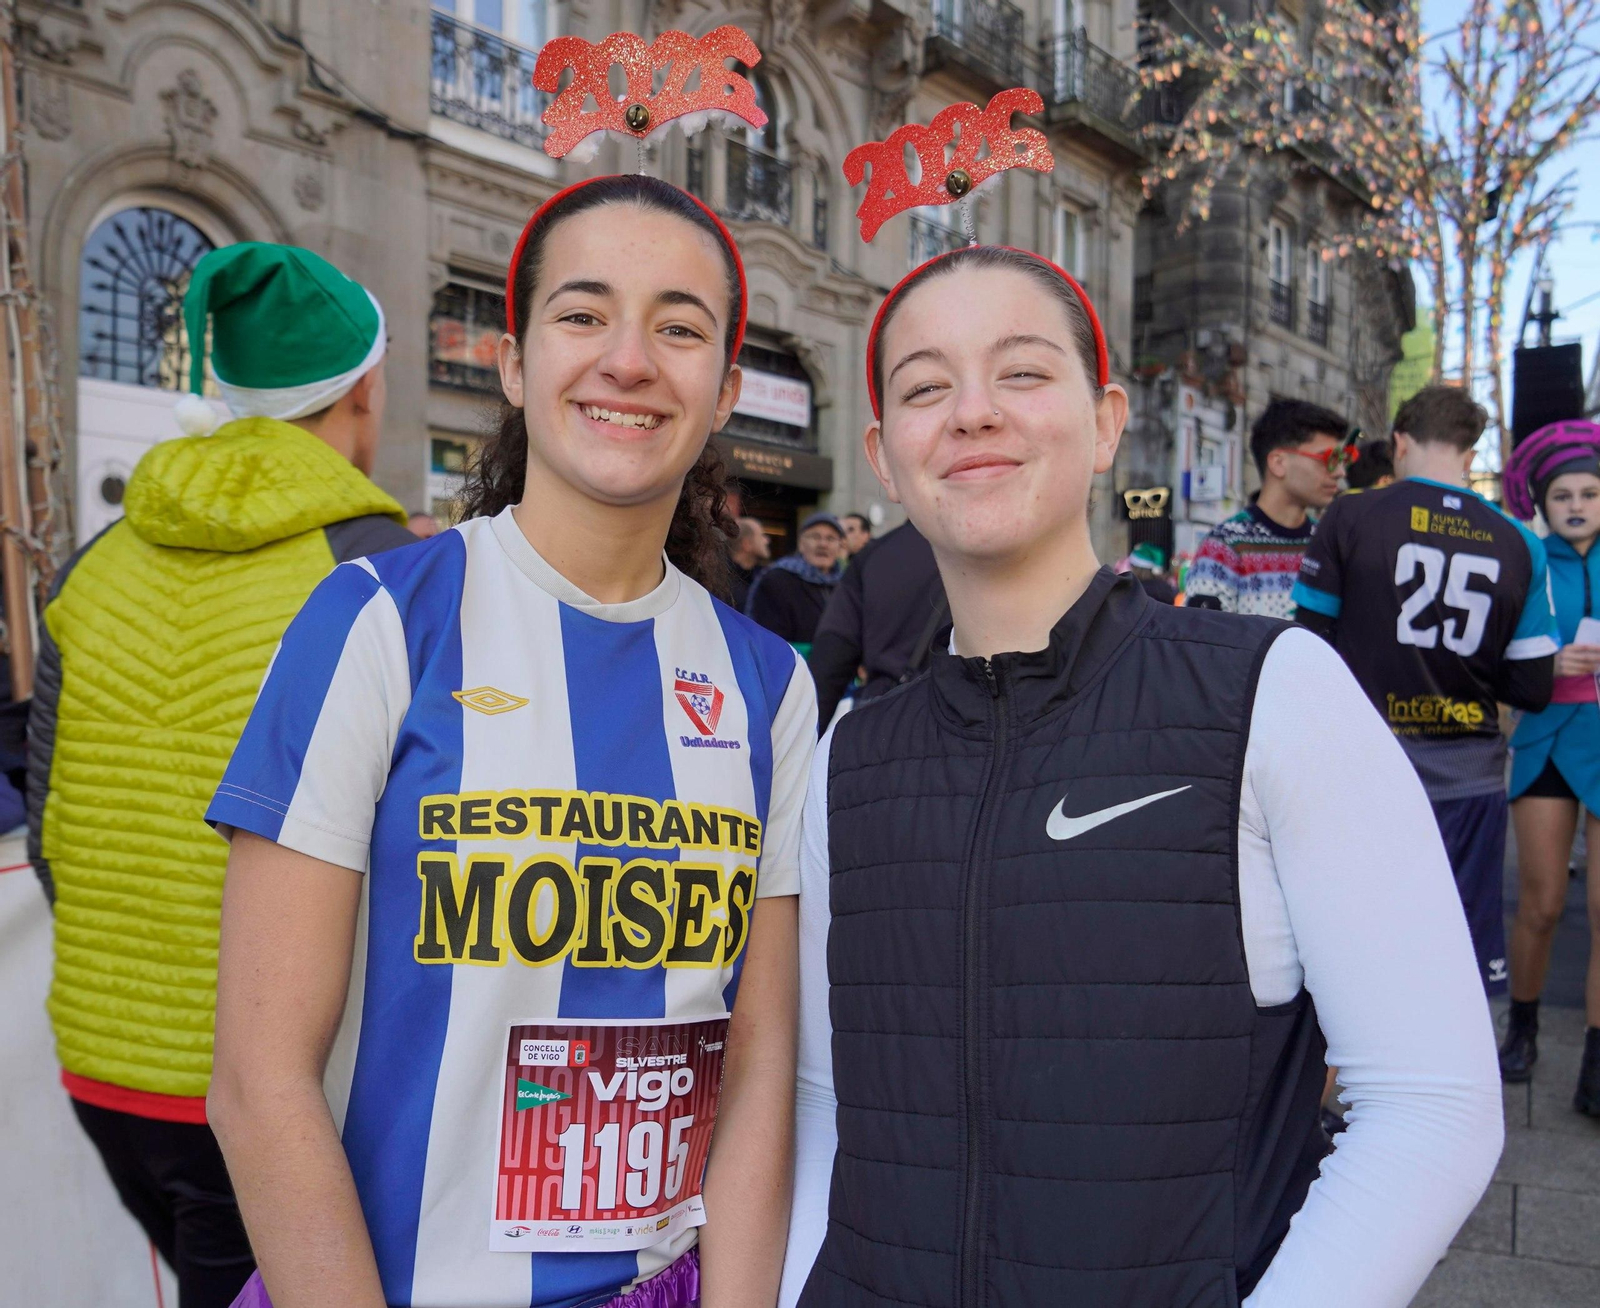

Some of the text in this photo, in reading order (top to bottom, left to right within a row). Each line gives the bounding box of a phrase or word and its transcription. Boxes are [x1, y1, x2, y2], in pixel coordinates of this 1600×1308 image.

[1431, 524, 1493, 543] DE GALICIA
[1432, 514, 1470, 528] XUNTA
[1395, 543, 1500, 657] 25
[422, 796, 758, 850] RESTAURANTE
[417, 860, 753, 963] MOISES
[523, 1044, 566, 1052] CONCELLO
[616, 1054, 687, 1068] SILVESTRE
[617, 1034, 689, 1058] SAN
[587, 1067, 694, 1111] vigo
[558, 1114, 695, 1210] 1195
